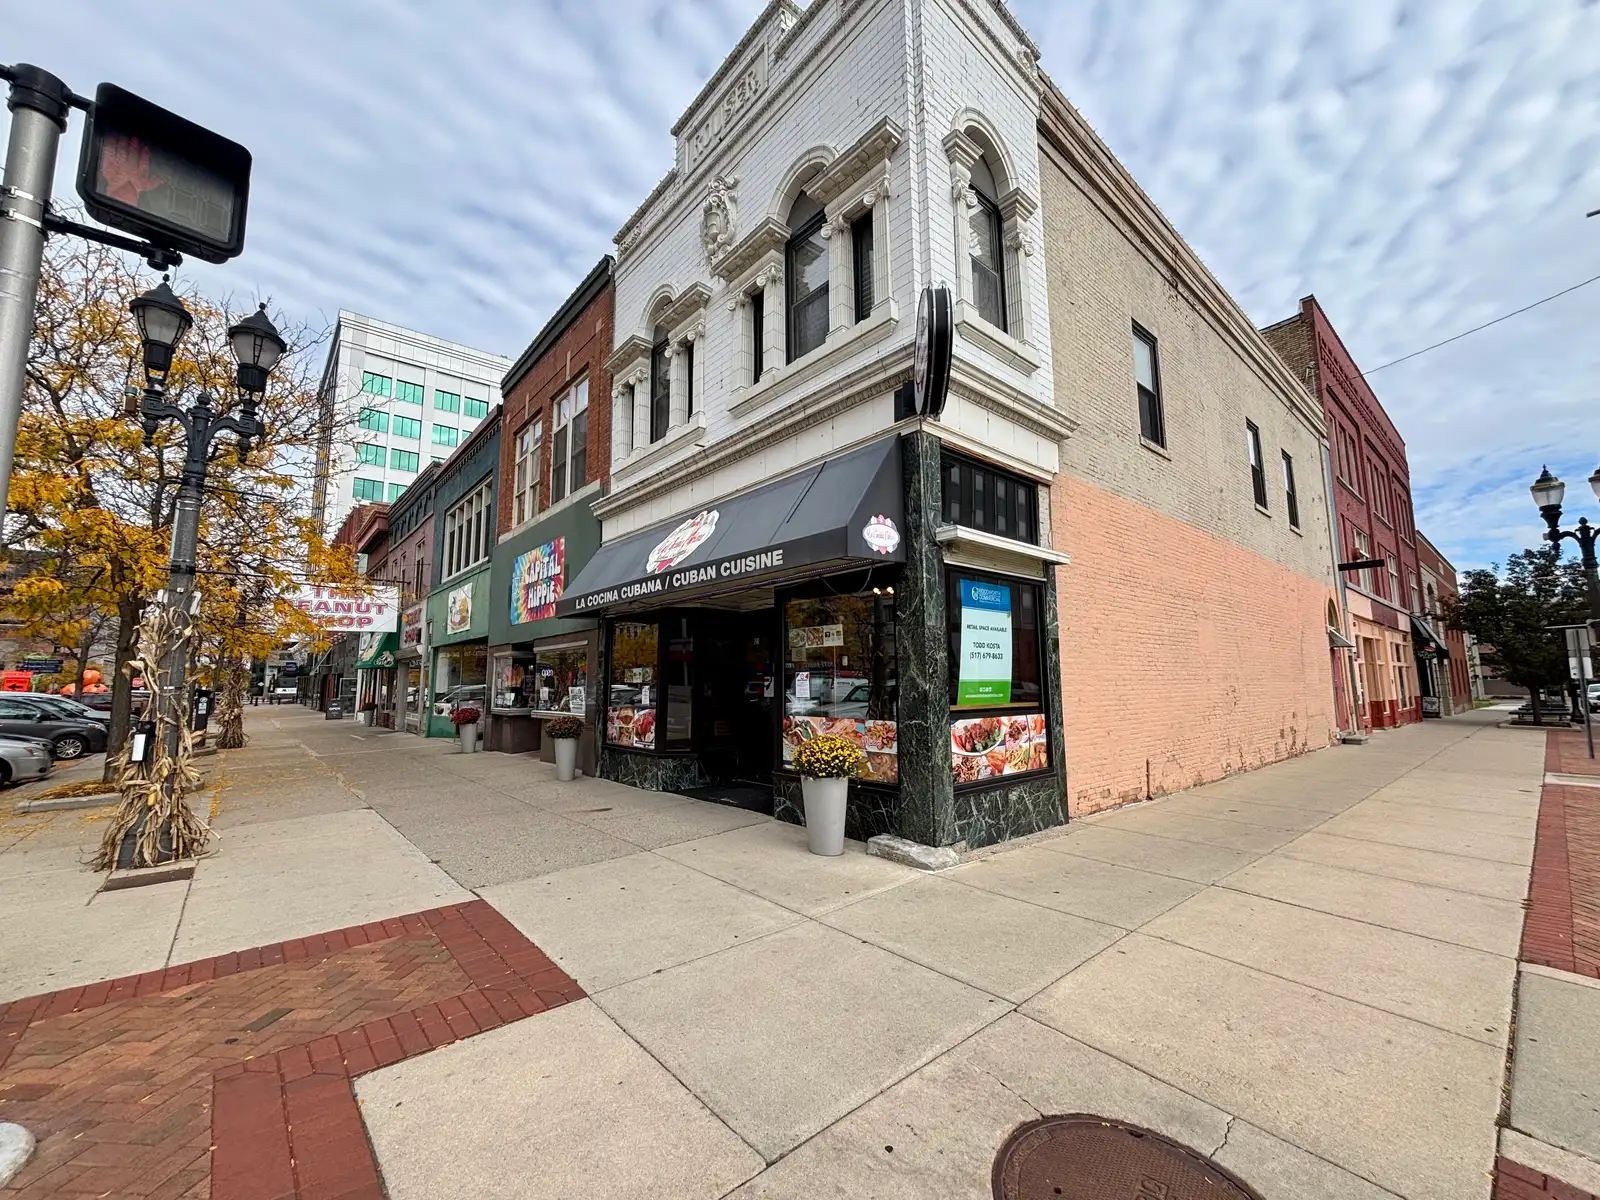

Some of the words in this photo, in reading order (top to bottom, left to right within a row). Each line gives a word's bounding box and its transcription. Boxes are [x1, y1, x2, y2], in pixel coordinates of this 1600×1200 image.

[575, 599, 585, 609] LA
[587, 592, 618, 606] COCINA
[621, 578, 662, 599] CUBANA
[665, 576, 670, 589] /
[672, 565, 716, 587] CUBAN
[720, 549, 783, 577] CUISINE
